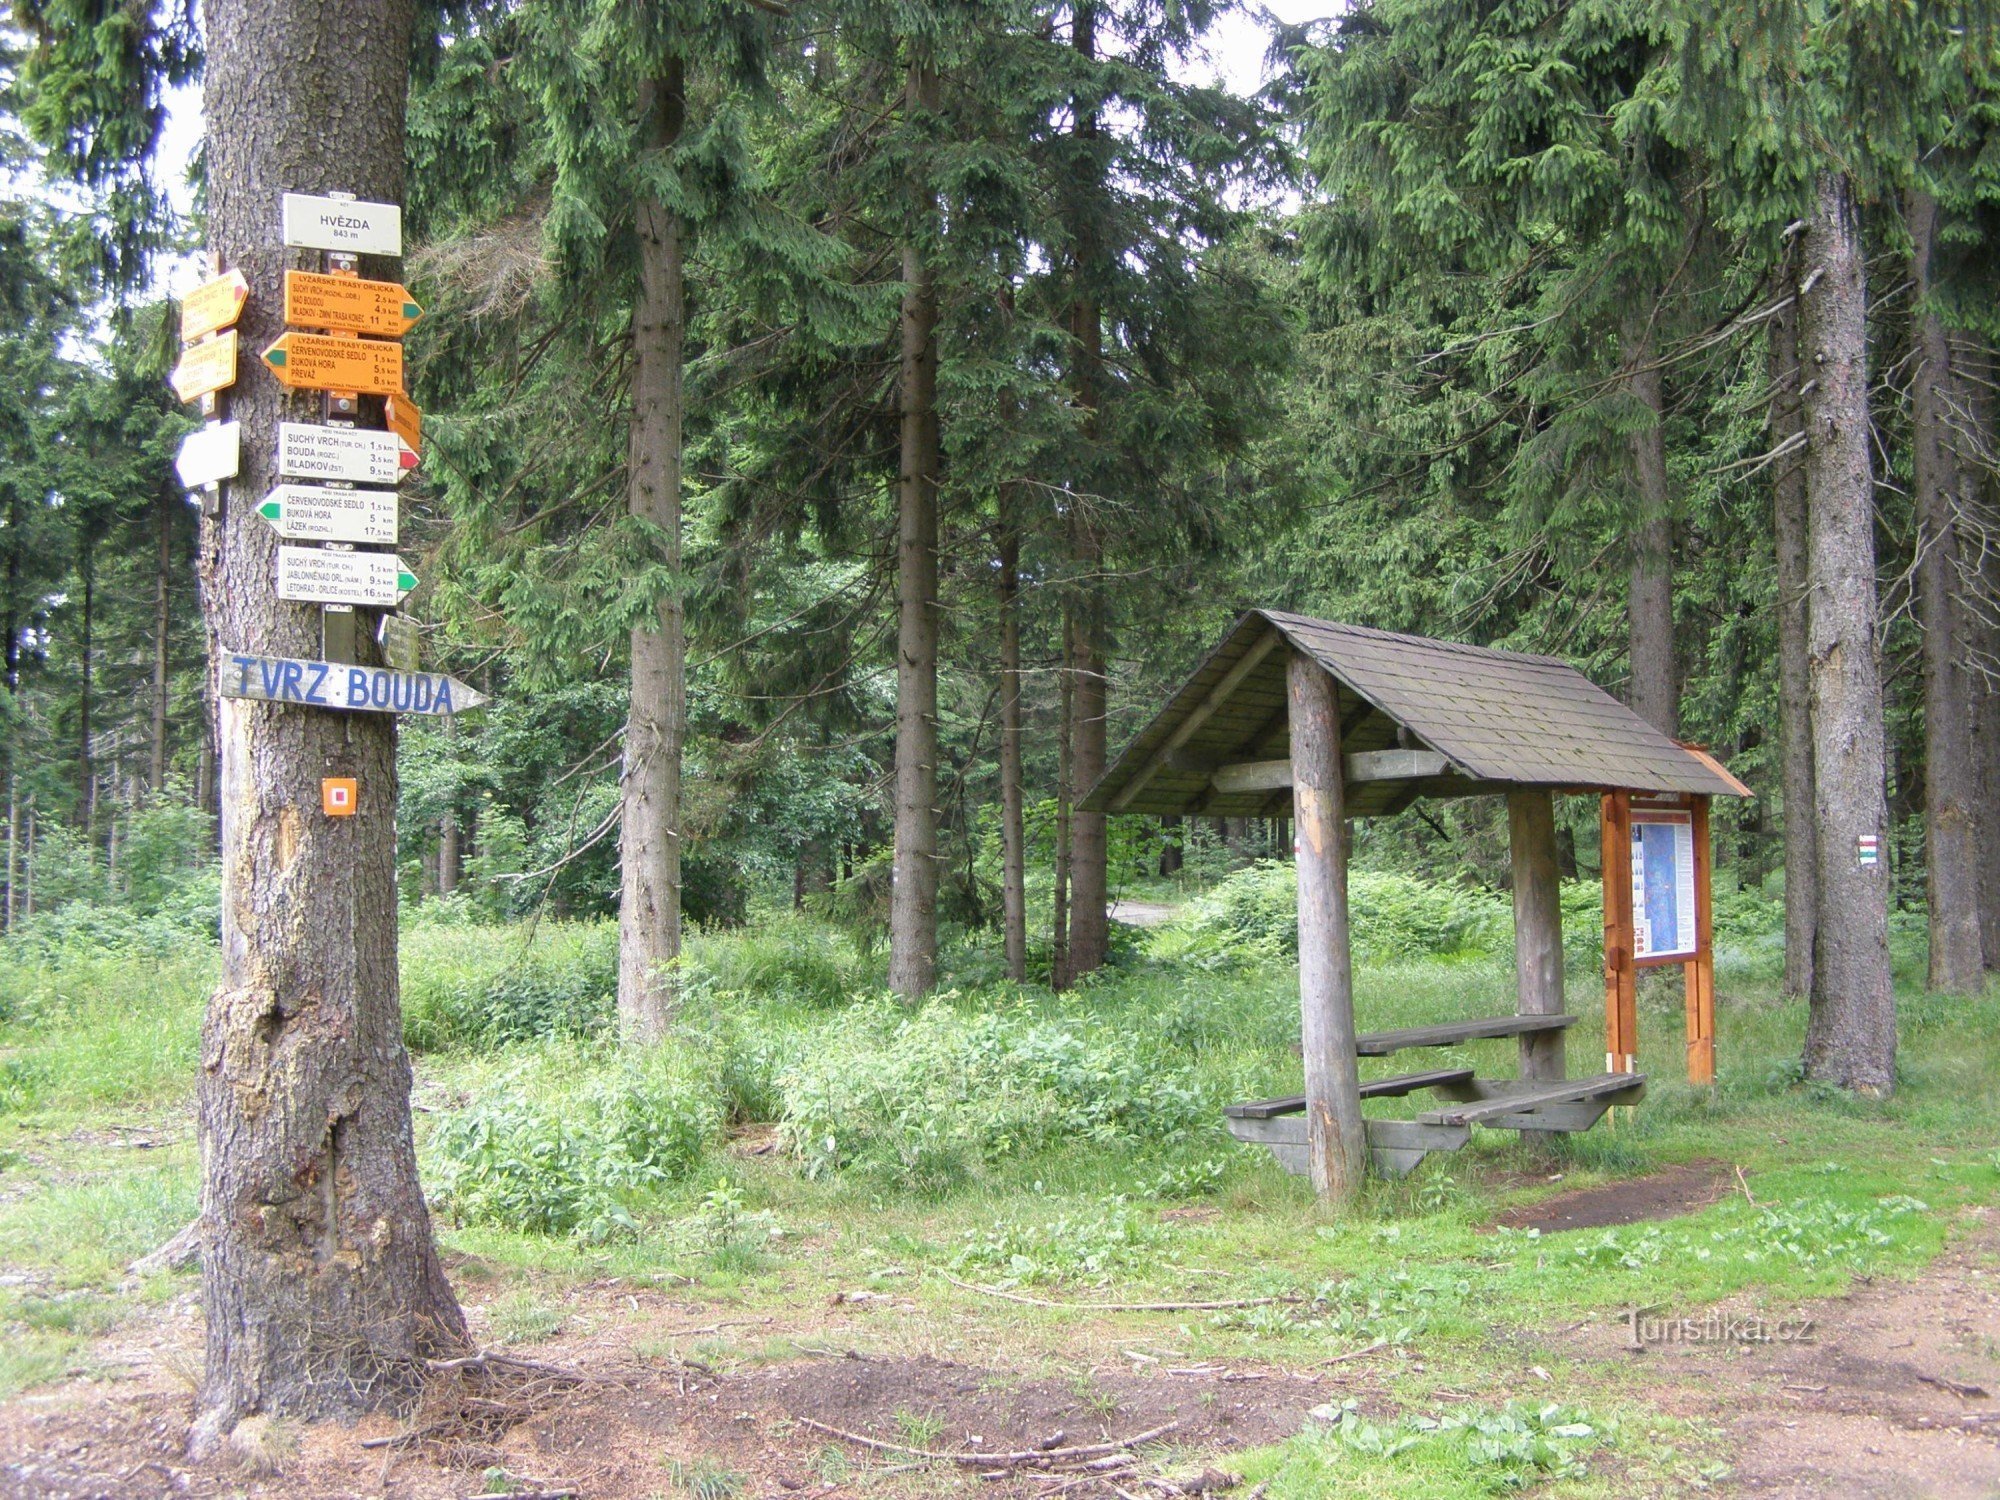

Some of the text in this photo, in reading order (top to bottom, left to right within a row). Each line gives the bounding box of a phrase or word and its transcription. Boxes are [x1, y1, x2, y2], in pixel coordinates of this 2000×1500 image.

[320, 214, 370, 230] HVĚZDA
[333, 229, 348, 238] 843
[298, 276, 394, 293] LYŽAŘSKÉ TRASY ORLICKA
[293, 295, 302, 304] NAD
[304, 296, 324, 306] BOUDOU
[375, 294, 386, 303] 2,5
[293, 306, 315, 317] MLADKOV
[332, 311, 347, 320] TRASA
[370, 316, 379, 324] 11
[298, 338, 334, 346] LYŽAŘSKÉ
[362, 344, 394, 352] ORLICKA
[291, 344, 344, 358] ČERVENOVODSKÉ
[346, 350, 366, 361] SEDLO
[374, 354, 385, 363] 1,5
[291, 357, 317, 367] BUKOVÁ
[318, 360, 336, 369] HORA
[374, 365, 385, 374] 5,5
[374, 376, 385, 385] 8,5
[288, 434, 315, 444] SUCHÝ
[317, 436, 339, 446] VRCH
[370, 442, 382, 450] 1,5
[287, 446, 315, 456] BOUDA
[370, 454, 382, 463] 3,5
[287, 459, 328, 470] MLADKOV
[370, 466, 382, 476] 9,5
[287, 494, 342, 508] ČERVENOVODSKÉ
[344, 500, 364, 510] SEDLO
[370, 502, 382, 511] 1,5
[287, 508, 312, 518] BUKOVÁ
[314, 510, 332, 520] HORA
[370, 514, 376, 522] 5
[287, 520, 307, 531] LÁZEK
[365, 527, 382, 536] 17,5
[287, 557, 308, 567] SUCHÝ
[308, 559, 325, 568] VRCH
[370, 564, 381, 572] 1,5
[318, 572, 330, 581] NAD
[370, 576, 381, 586] 9,5
[287, 583, 315, 592] LETOHRAD
[318, 585, 338, 594] ORLICE
[364, 588, 381, 598] 16,5
[232, 657, 454, 714] TVRZ BOUDA
